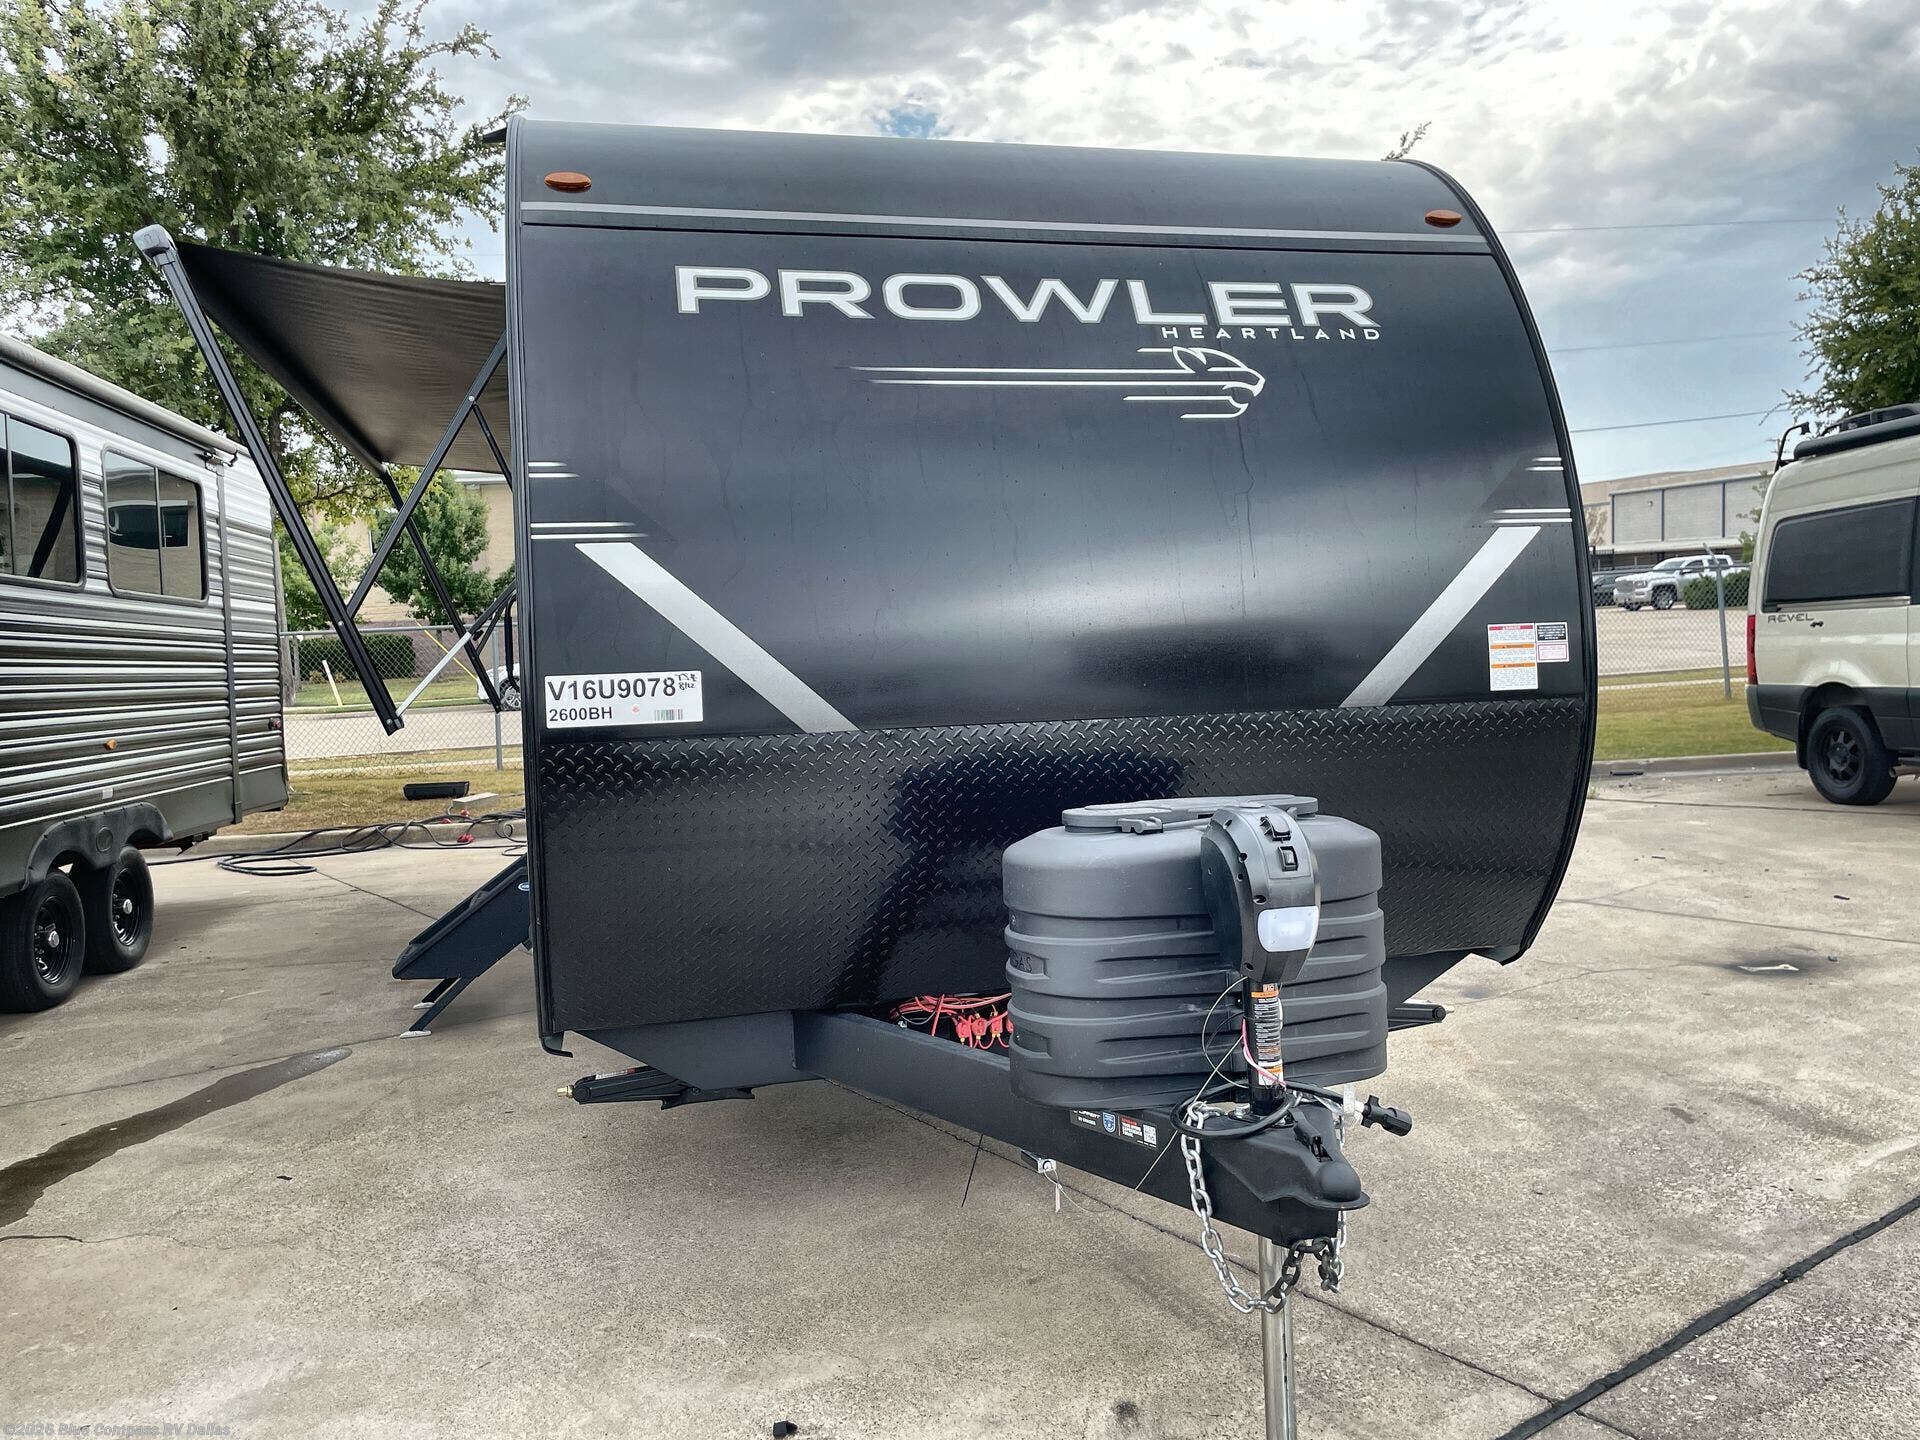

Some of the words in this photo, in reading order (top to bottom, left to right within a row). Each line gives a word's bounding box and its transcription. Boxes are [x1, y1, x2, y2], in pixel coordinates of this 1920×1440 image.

[675, 265, 1381, 328] PROWLER
[1161, 326, 1381, 341] HEARTLAND
[1767, 612, 1815, 623] REVEL
[547, 677, 676, 701] V16U9078
[549, 706, 613, 722] 2600BH
